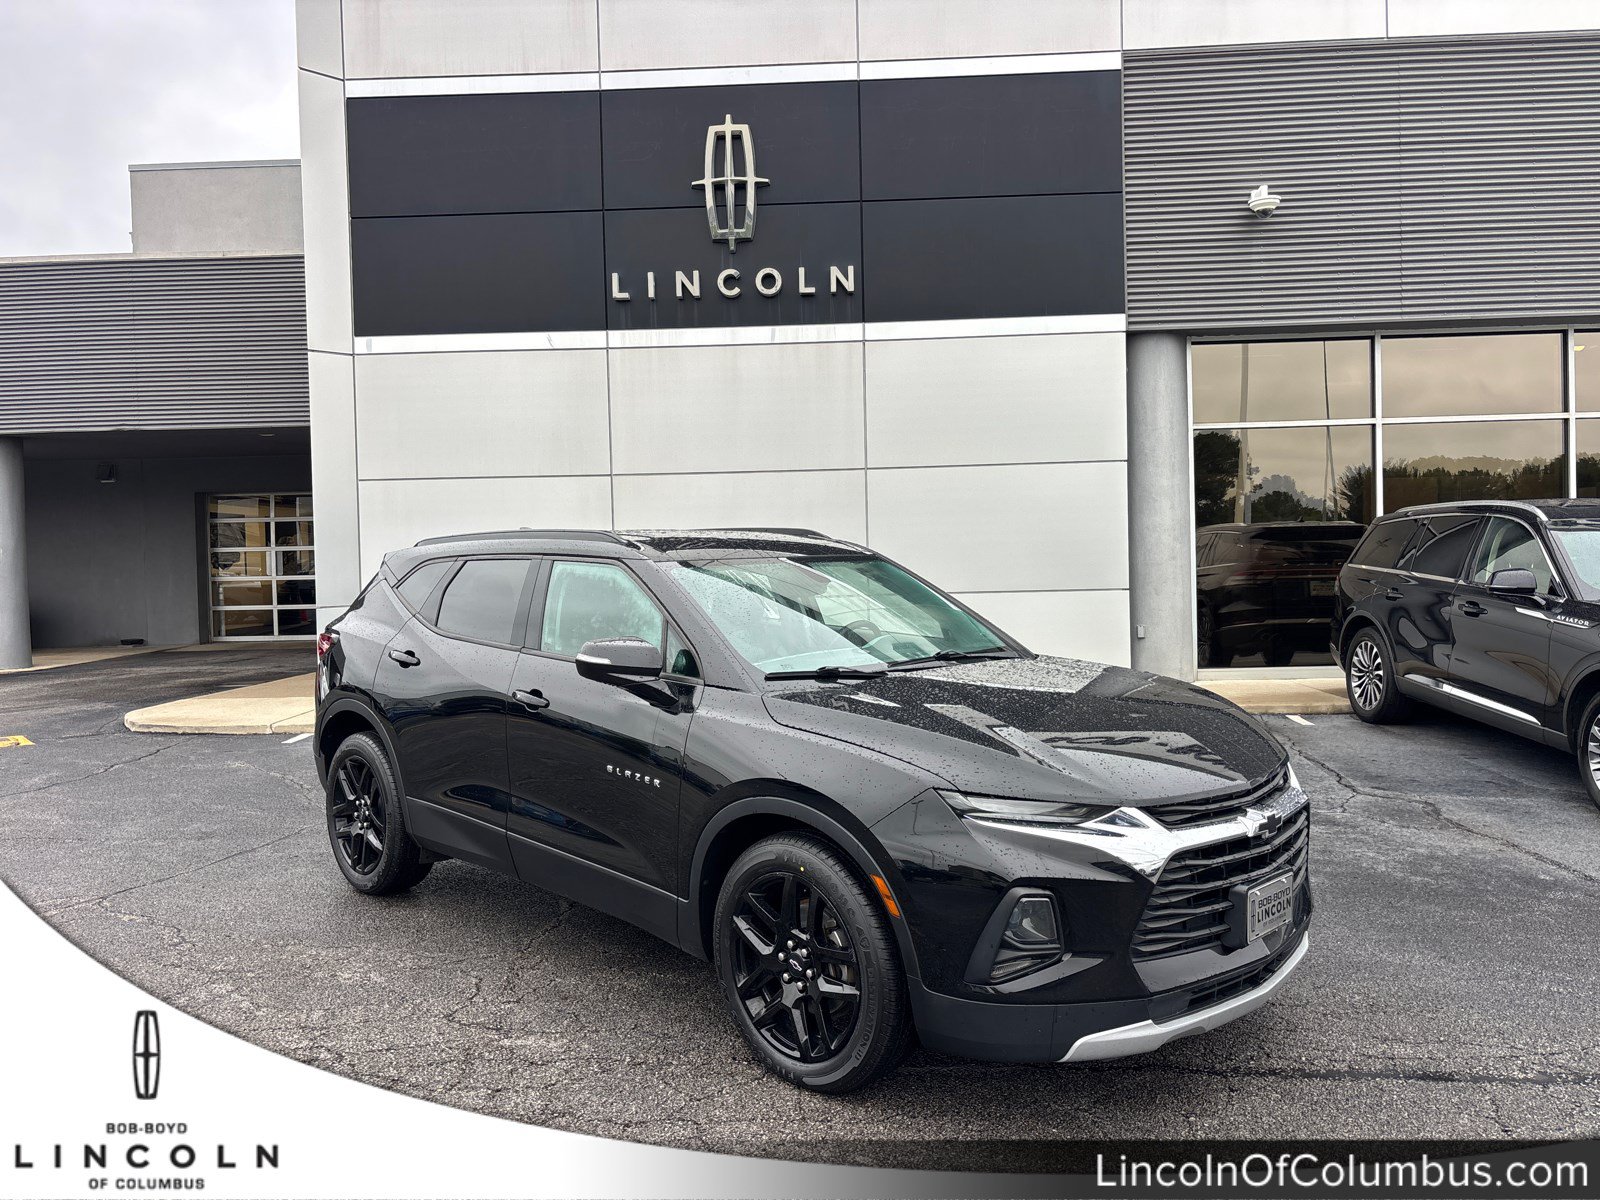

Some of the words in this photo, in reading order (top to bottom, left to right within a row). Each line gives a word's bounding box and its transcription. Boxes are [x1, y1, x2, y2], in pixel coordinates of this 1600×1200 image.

[611, 265, 855, 300] LINCOLN
[1556, 614, 1590, 626] AVIATOR
[606, 764, 660, 788] BLAZER
[1258, 886, 1291, 909] BOB-BOYD
[1257, 897, 1292, 923] LINCOLN
